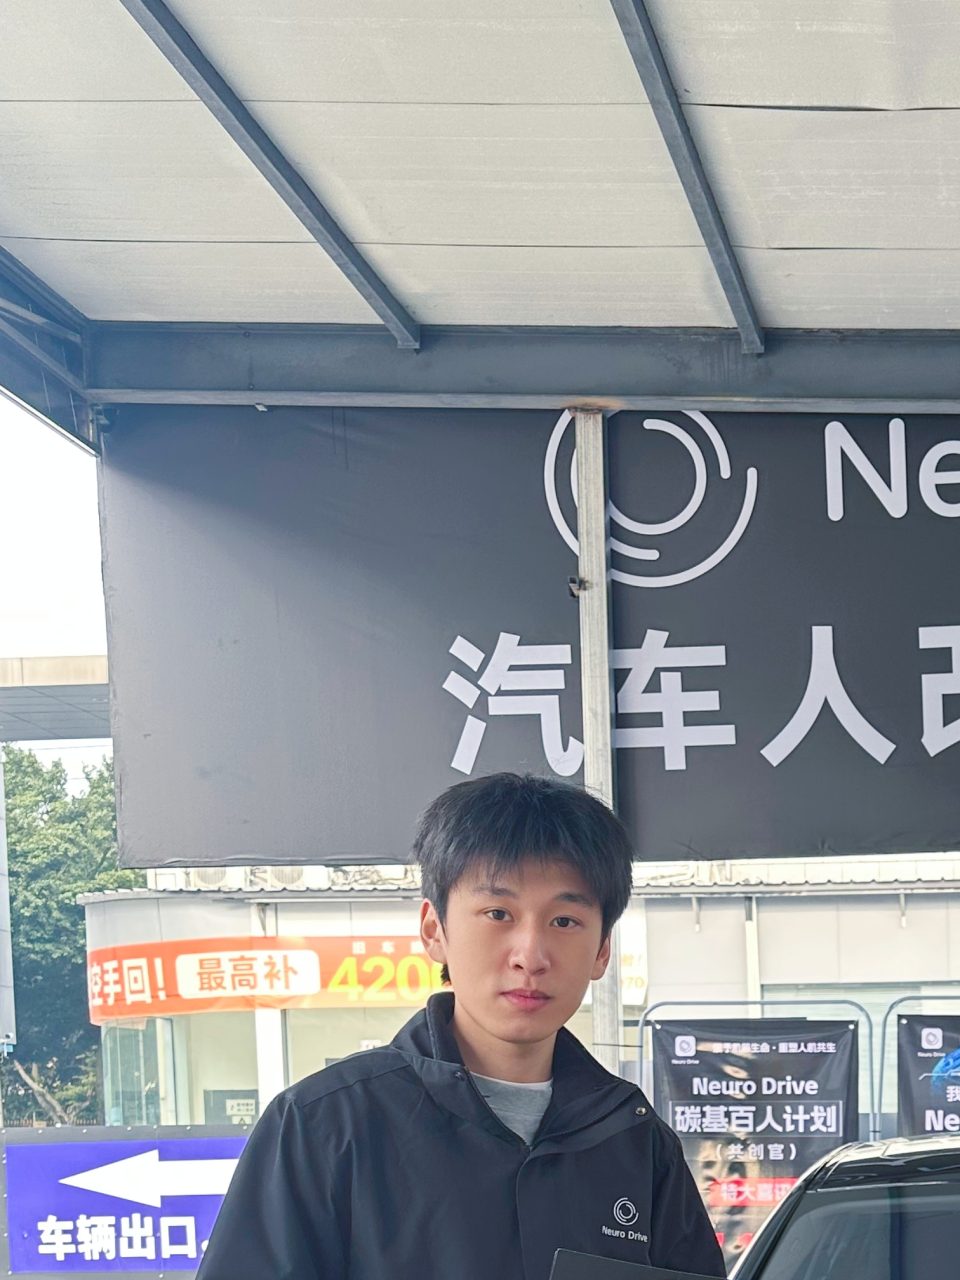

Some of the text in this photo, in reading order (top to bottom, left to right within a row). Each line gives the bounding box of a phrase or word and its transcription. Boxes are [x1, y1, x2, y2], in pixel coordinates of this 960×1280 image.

[197, 953, 298, 992] 最高补
[692, 1075, 819, 1095] Neuro Drive
[674, 1105, 837, 1133] 碳基百人计划
[601, 1225, 648, 1243] Neuro Drive
